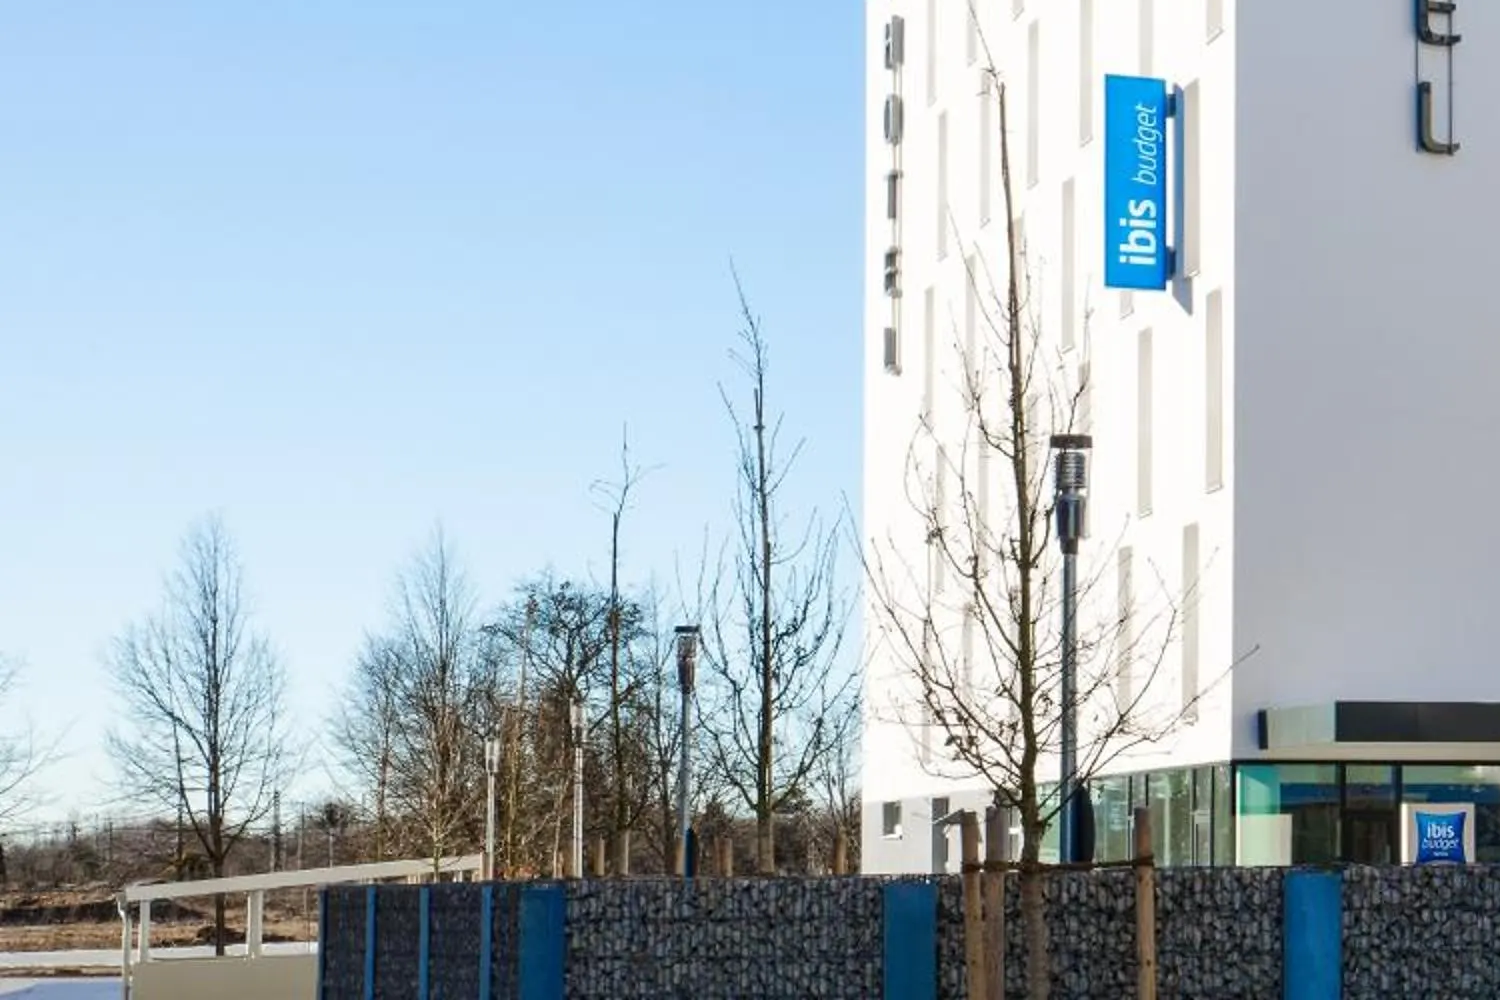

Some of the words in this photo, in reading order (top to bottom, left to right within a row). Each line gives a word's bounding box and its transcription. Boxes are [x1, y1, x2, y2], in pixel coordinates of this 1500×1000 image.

[1132, 103, 1163, 185] budget
[1119, 199, 1157, 265] ibis
[1427, 822, 1455, 838] ibis
